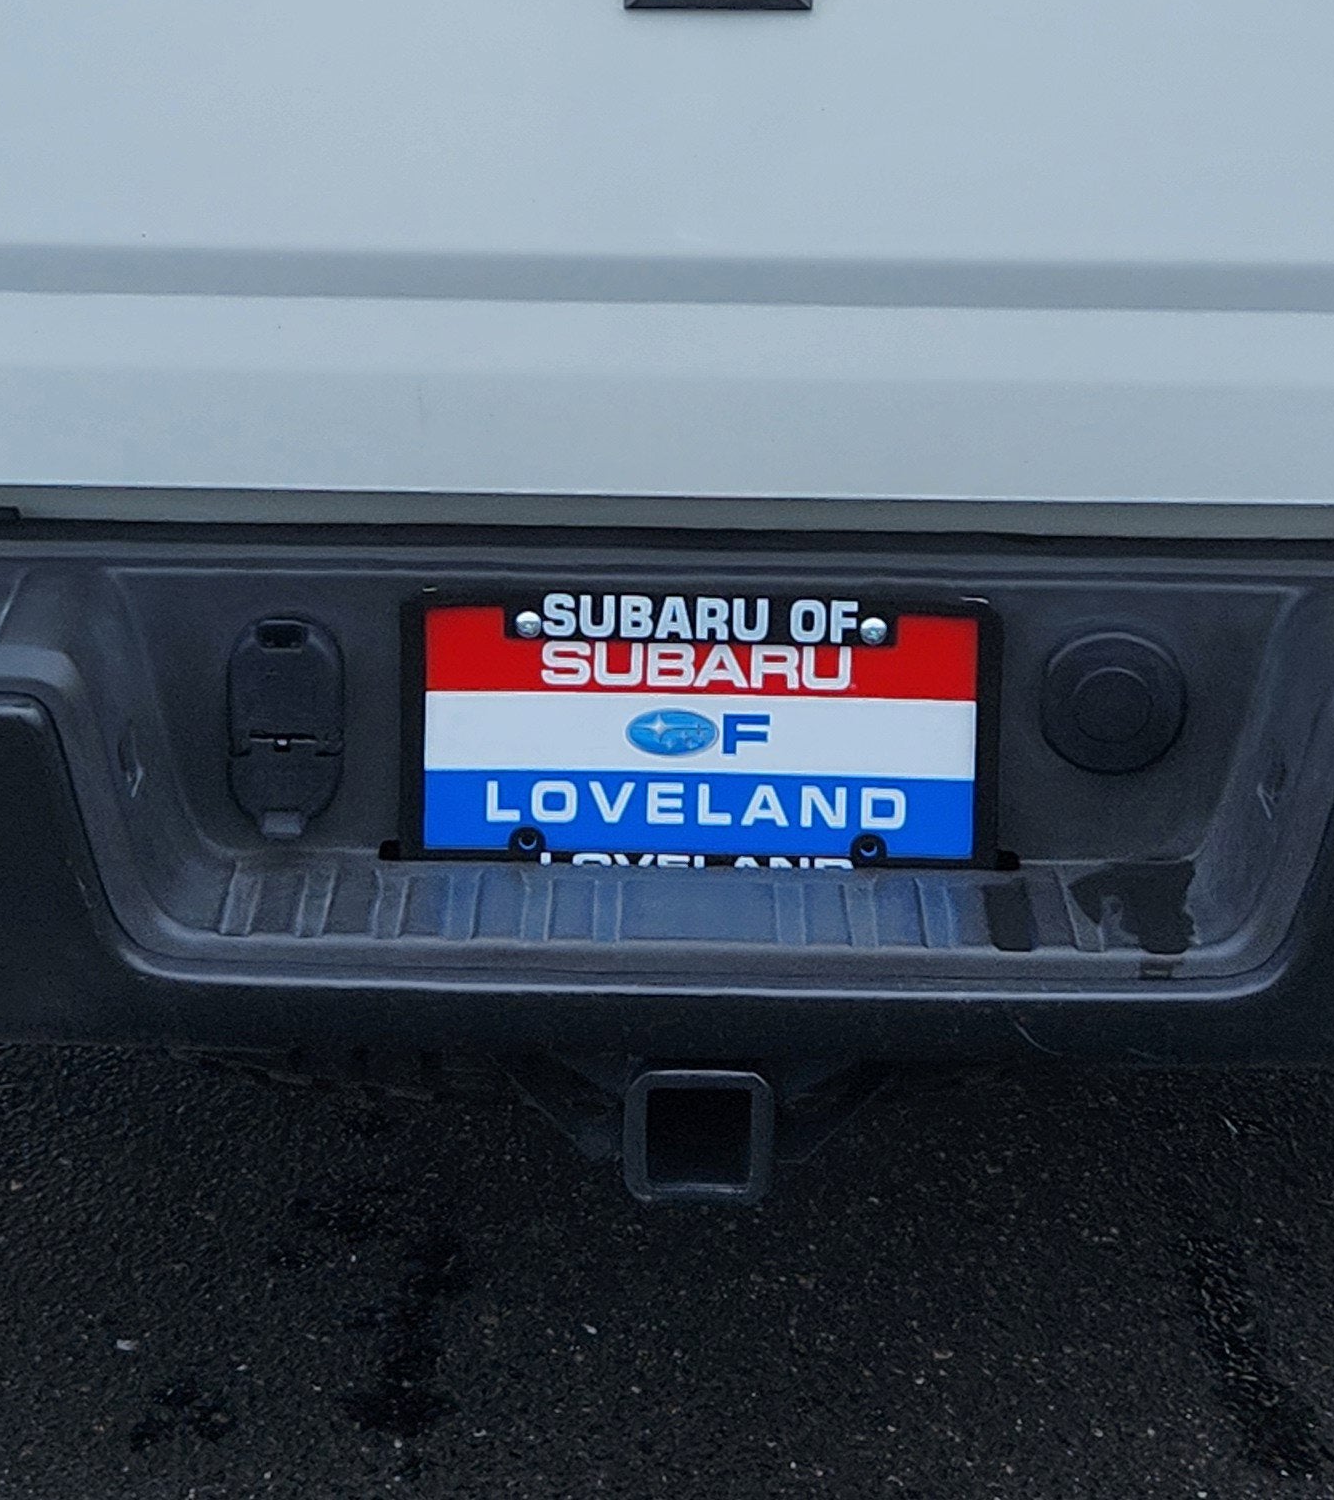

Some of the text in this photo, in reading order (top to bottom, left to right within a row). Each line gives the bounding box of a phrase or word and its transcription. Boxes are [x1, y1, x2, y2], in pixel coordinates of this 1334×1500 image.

[542, 592, 859, 644] SUBARU OF
[540, 640, 852, 690] SUBARU
[485, 780, 906, 830] LOVELAND
